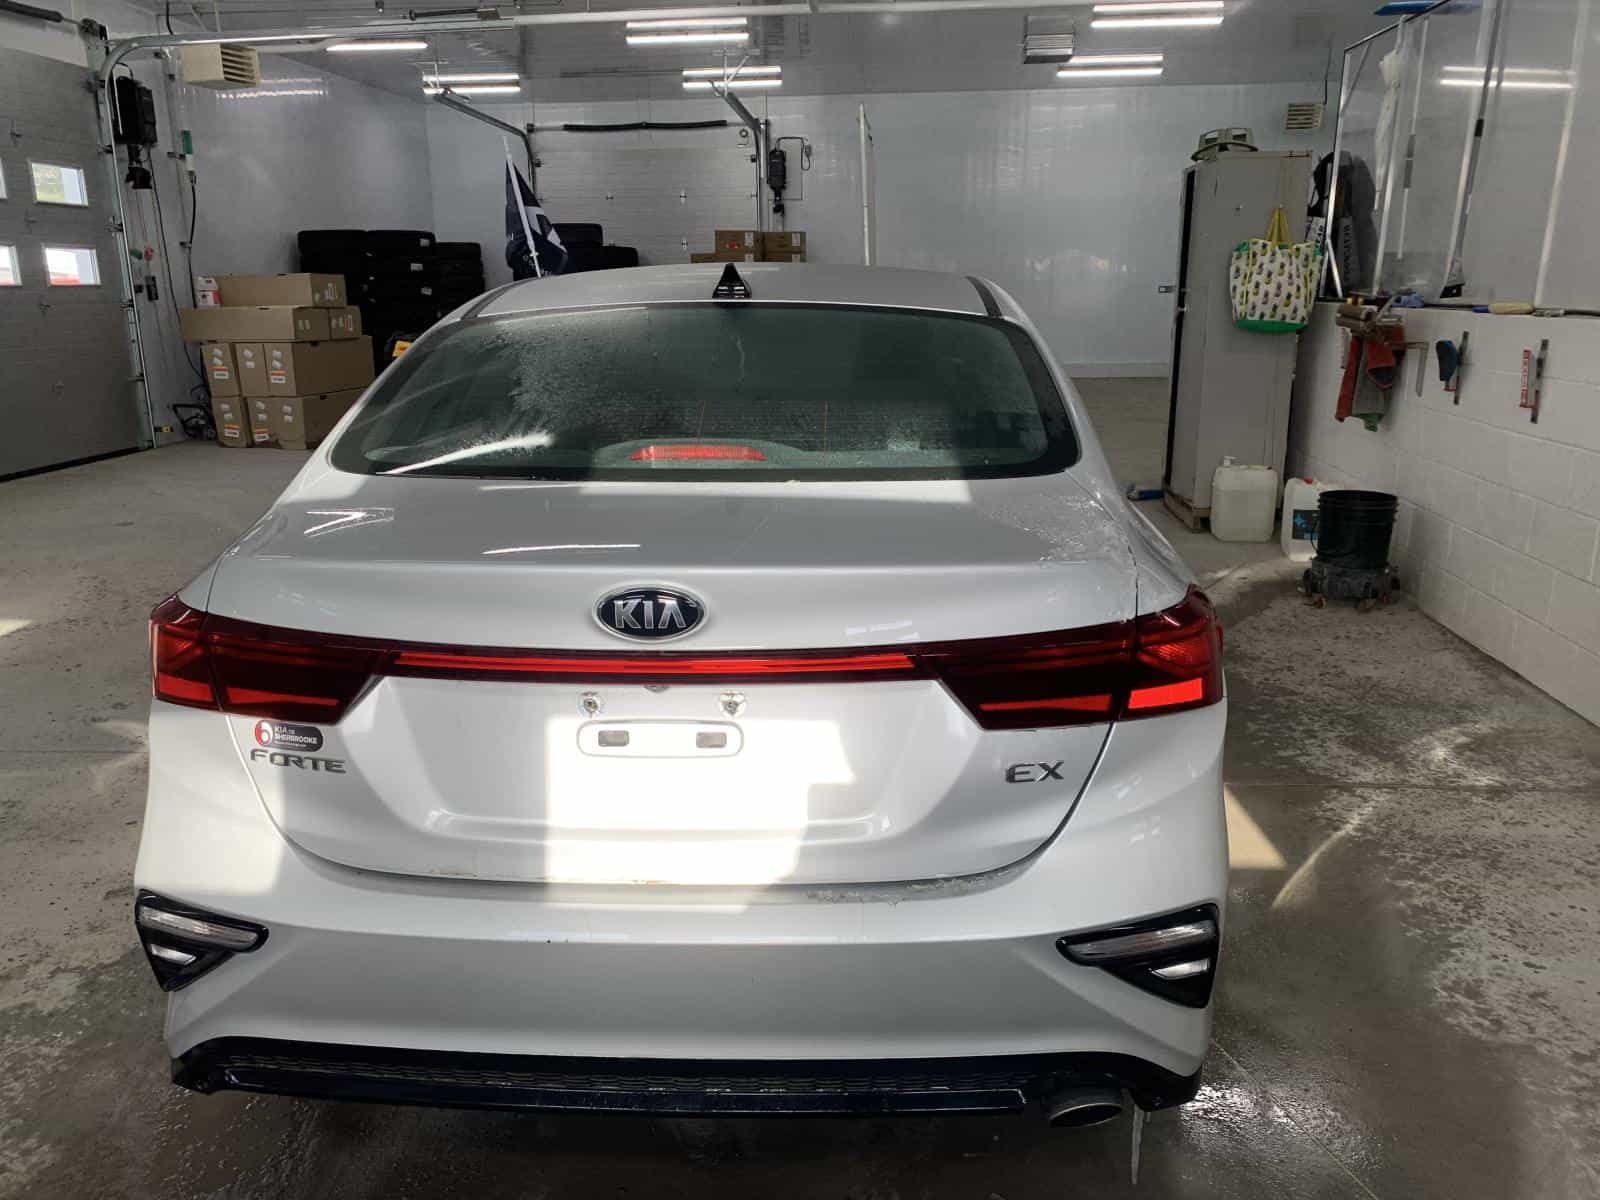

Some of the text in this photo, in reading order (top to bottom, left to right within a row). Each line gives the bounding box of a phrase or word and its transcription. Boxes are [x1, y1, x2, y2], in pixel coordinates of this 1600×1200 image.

[613, 598, 687, 629] KIA
[274, 725, 287, 734] KIA
[274, 734, 318, 745] SHERBROOKE
[250, 749, 346, 773] FORTE
[1005, 761, 1064, 783] EX
